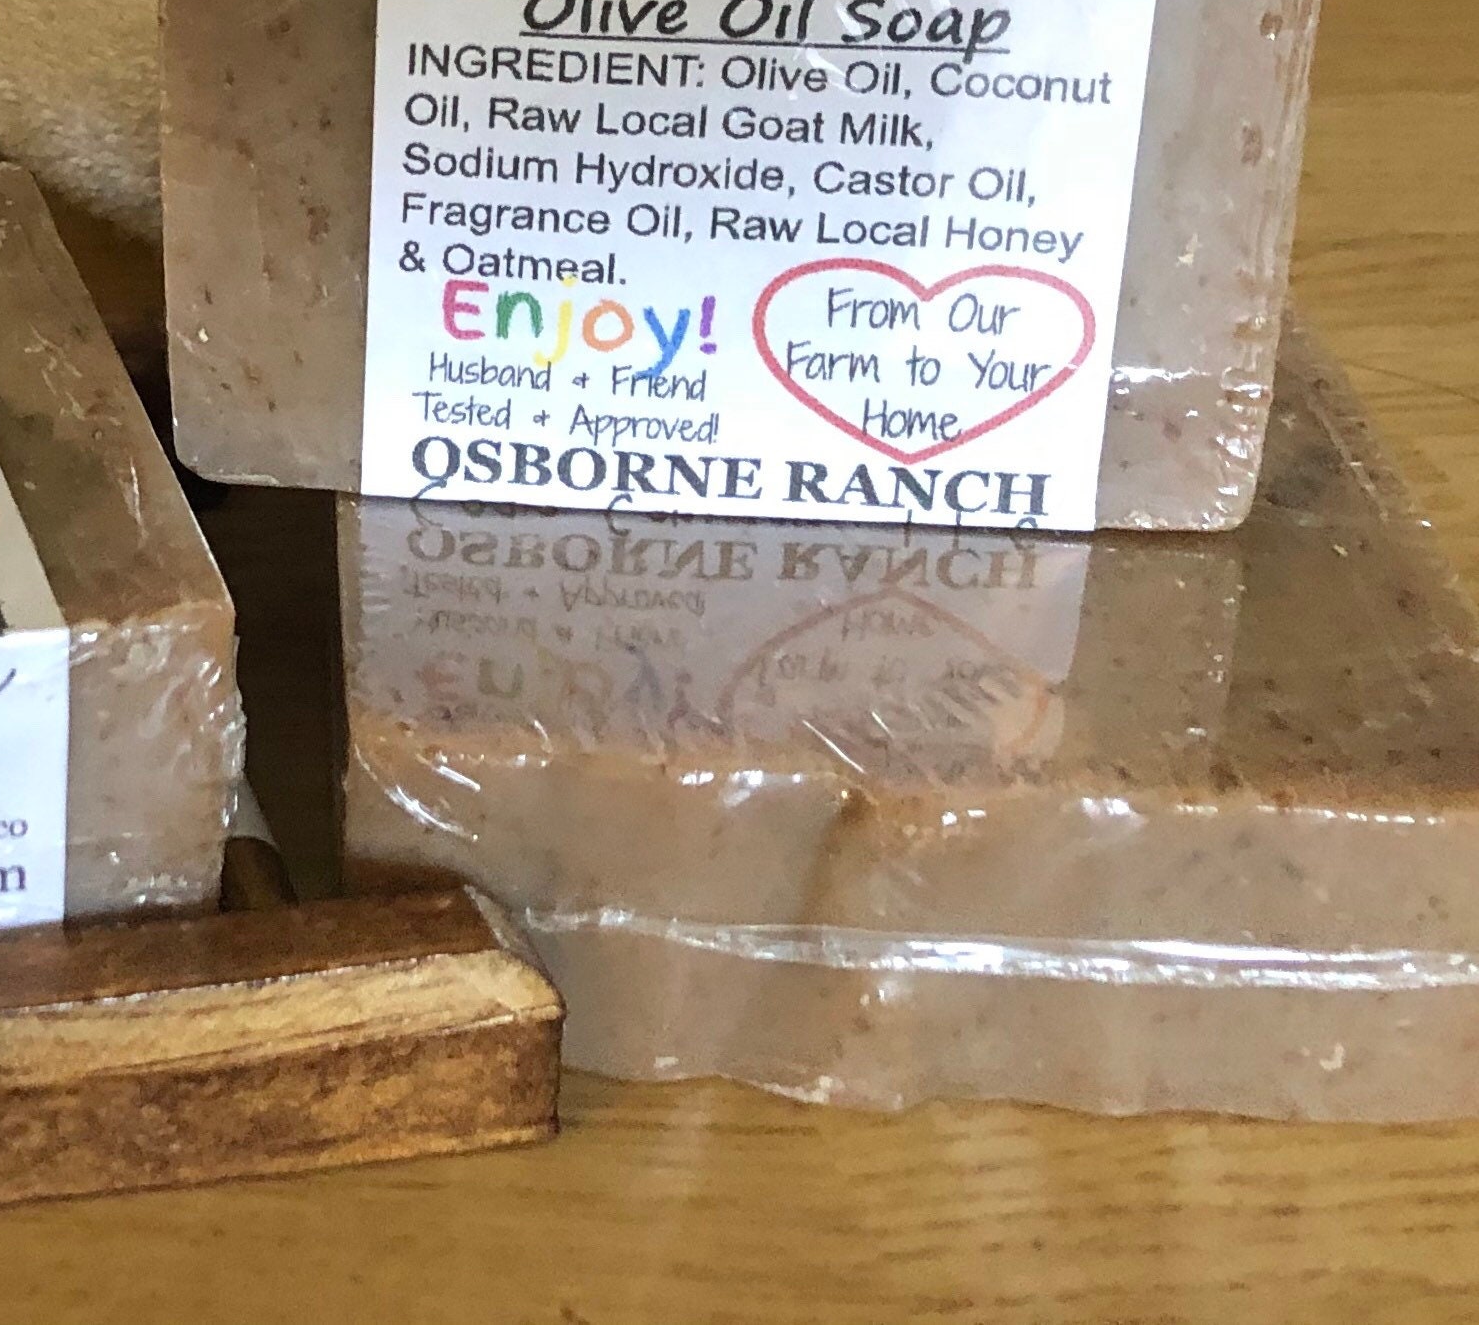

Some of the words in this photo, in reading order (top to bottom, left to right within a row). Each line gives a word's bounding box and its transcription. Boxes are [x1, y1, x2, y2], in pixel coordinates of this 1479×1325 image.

[407, 43, 707, 89] INGREDIENT:
[721, 56, 829, 94] Olive
[844, 61, 914, 101] Oil,
[929, 63, 1112, 106] Coconut
[403, 93, 470, 134] Oil,
[488, 99, 582, 136] Raw
[595, 103, 708, 141] Local
[722, 107, 826, 144] Goat
[839, 112, 934, 152] Milk,
[402, 144, 559, 184] Sodium
[574, 152, 797, 199] Hydroxide,
[813, 161, 956, 201] Castor
[967, 167, 1037, 210] Oil,
[401, 194, 611, 246] Fragrance
[627, 205, 695, 244] Oil,
[709, 208, 804, 244] Raw
[817, 213, 930, 249] Local
[945, 218, 1084, 263] Honey
[398, 242, 427, 274] &
[442, 243, 629, 287] Oatmeal.
[441, 278, 719, 379] Enjoy!
[826, 286, 920, 332] From
[947, 294, 1021, 334] Our
[429, 352, 554, 394] Husband
[611, 366, 707, 402] Friend
[786, 339, 881, 385] Farm
[905, 346, 940, 388] to
[967, 349, 1051, 394] Your
[412, 391, 512, 430] Tested
[568, 408, 720, 447] Approved!
[863, 398, 958, 443] Home
[412, 435, 764, 503] OSBORNE
[783, 459, 1052, 517] RANCH
